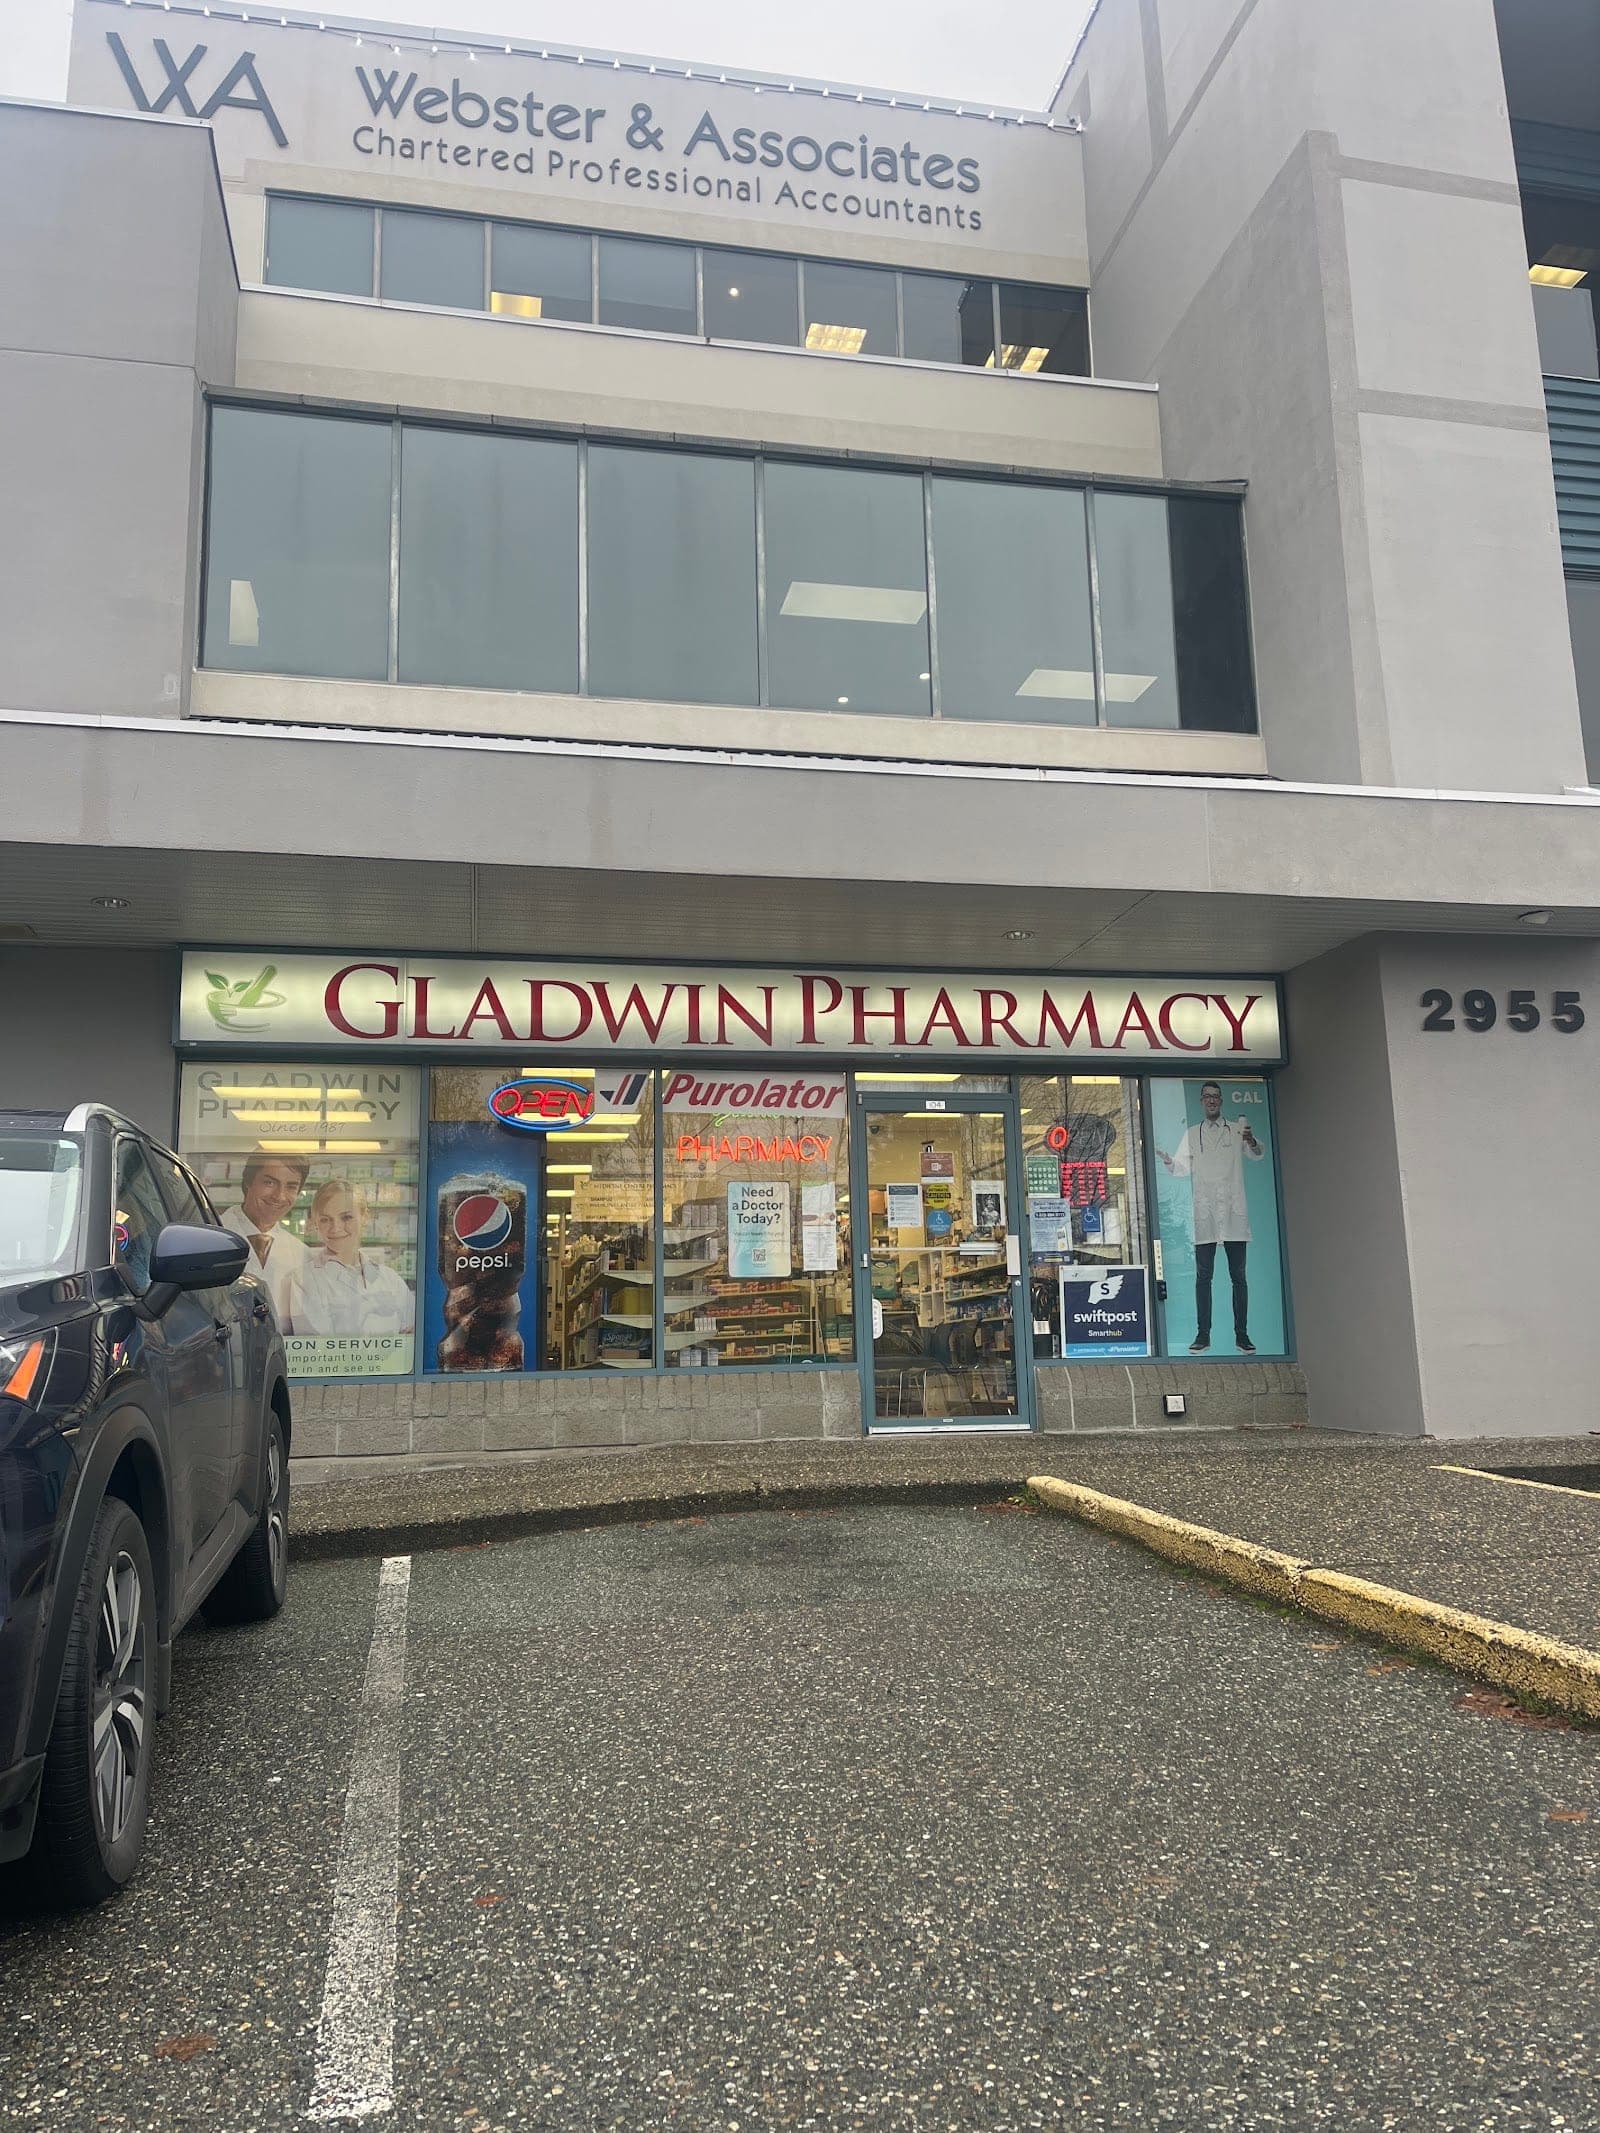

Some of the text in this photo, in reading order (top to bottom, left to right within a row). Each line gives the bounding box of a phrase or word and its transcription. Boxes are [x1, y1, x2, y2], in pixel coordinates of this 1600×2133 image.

[106, 32, 288, 146] WA
[355, 66, 980, 193] Webster & Associates
[353, 125, 982, 230] Chartered Professional Accountants
[324, 963, 1263, 1051] GLADWIN PHARMACY
[1420, 989, 1585, 1033] 2955
[198, 1071, 401, 1093] GLADWIN
[662, 1074, 845, 1109] Purolator
[493, 1089, 593, 1117] OPEN
[1232, 1091, 1263, 1104] CAL
[199, 1100, 400, 1120] PHARMACY
[259, 1121, 306, 1133] Since
[677, 1135, 833, 1162] PHARMACY
[742, 1187, 774, 1197] Need
[732, 1200, 784, 1211] a Doctor
[737, 1213, 780, 1225] Today?
[456, 1253, 508, 1272] pepsi
[1074, 1310, 1137, 1325] swiftpost
[285, 1339, 403, 1350] ION SERVICE
[288, 1354, 345, 1363] important
[351, 1354, 362, 1362] to
[303, 1364, 313, 1373] in
[318, 1364, 339, 1373] and
